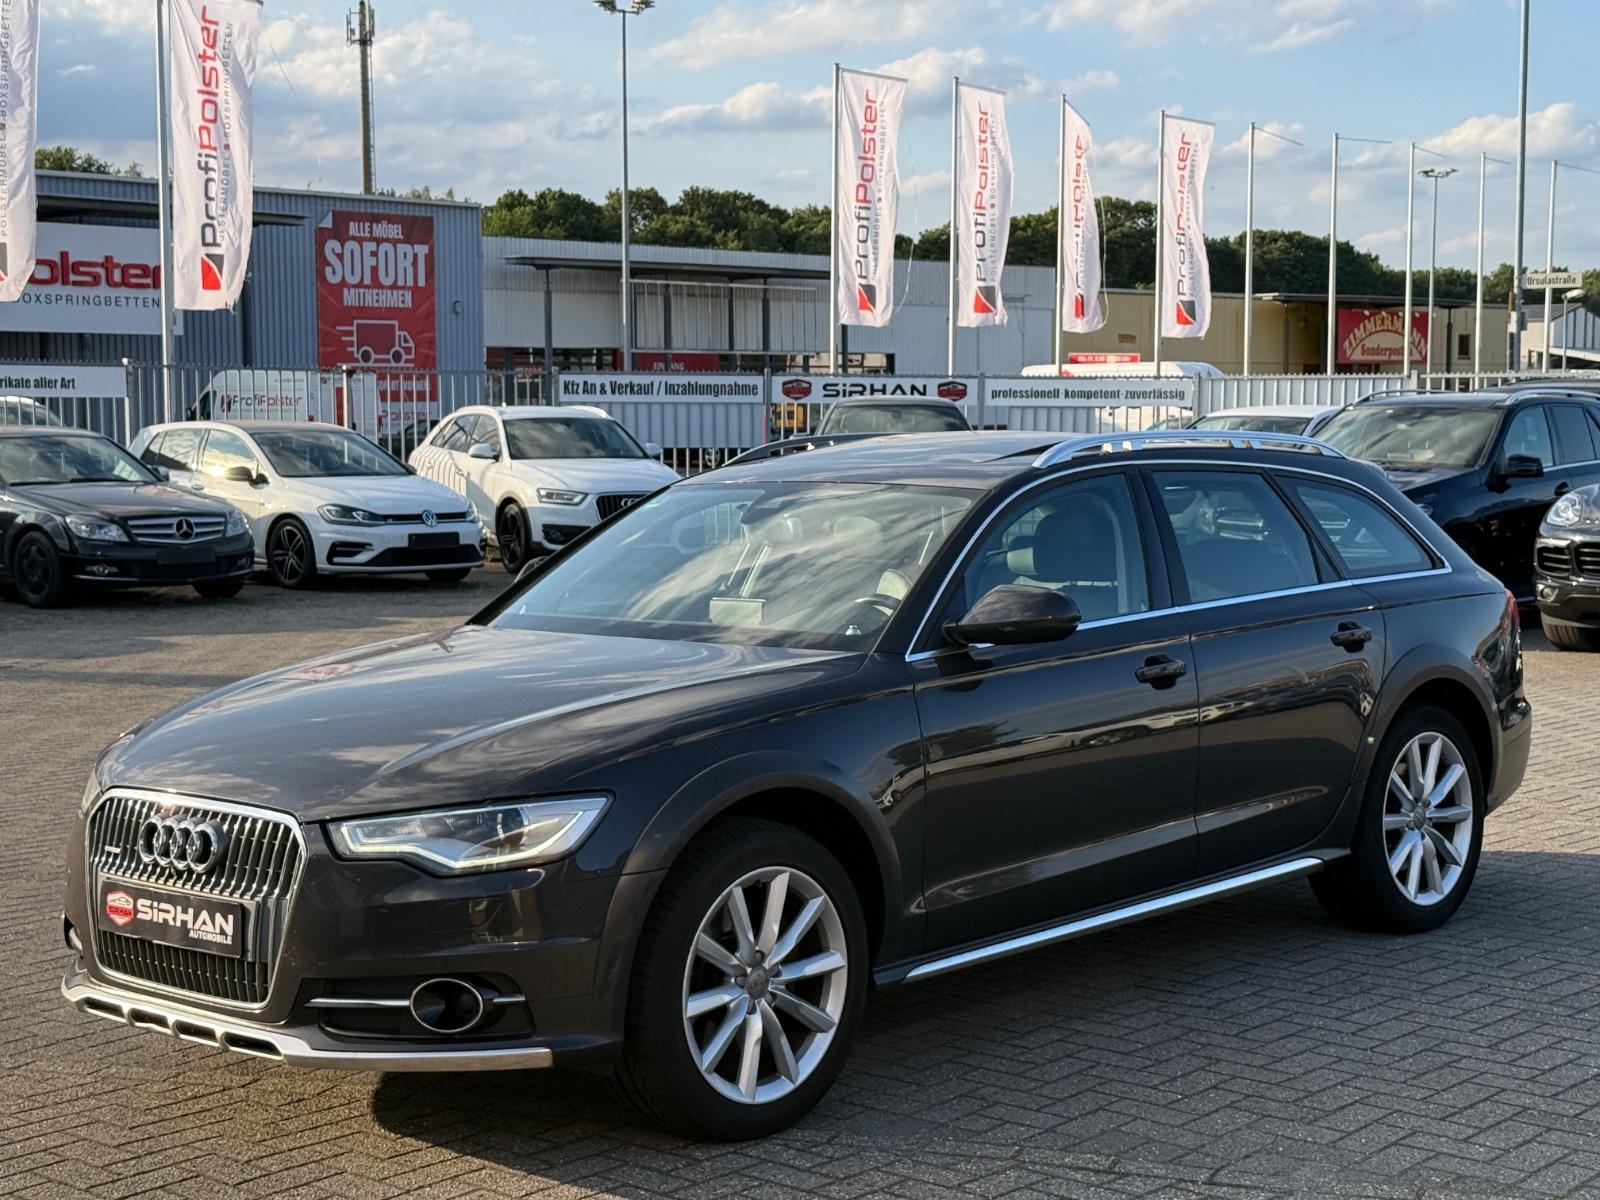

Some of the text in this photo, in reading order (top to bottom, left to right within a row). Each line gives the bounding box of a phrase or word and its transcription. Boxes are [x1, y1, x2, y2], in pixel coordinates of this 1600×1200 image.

[197, 5, 222, 248] ProfiPolster
[854, 89, 878, 280] ProfiPolster
[973, 102, 989, 282] ProfiPolster
[349, 220, 404, 239] ALLE MÖBEL
[324, 239, 429, 288] SOFORT
[343, 287, 412, 309] MITNEHMEN
[1343, 314, 1428, 358] ZIMMERMNN
[653, 361, 685, 370] EINANG
[34, 376, 58, 389] aller
[60, 377, 76, 390] Art
[563, 380, 758, 397] Kfz An & Verkauf / Inzahlungnahme
[189, 930, 232, 944] AUTOMOBILE
